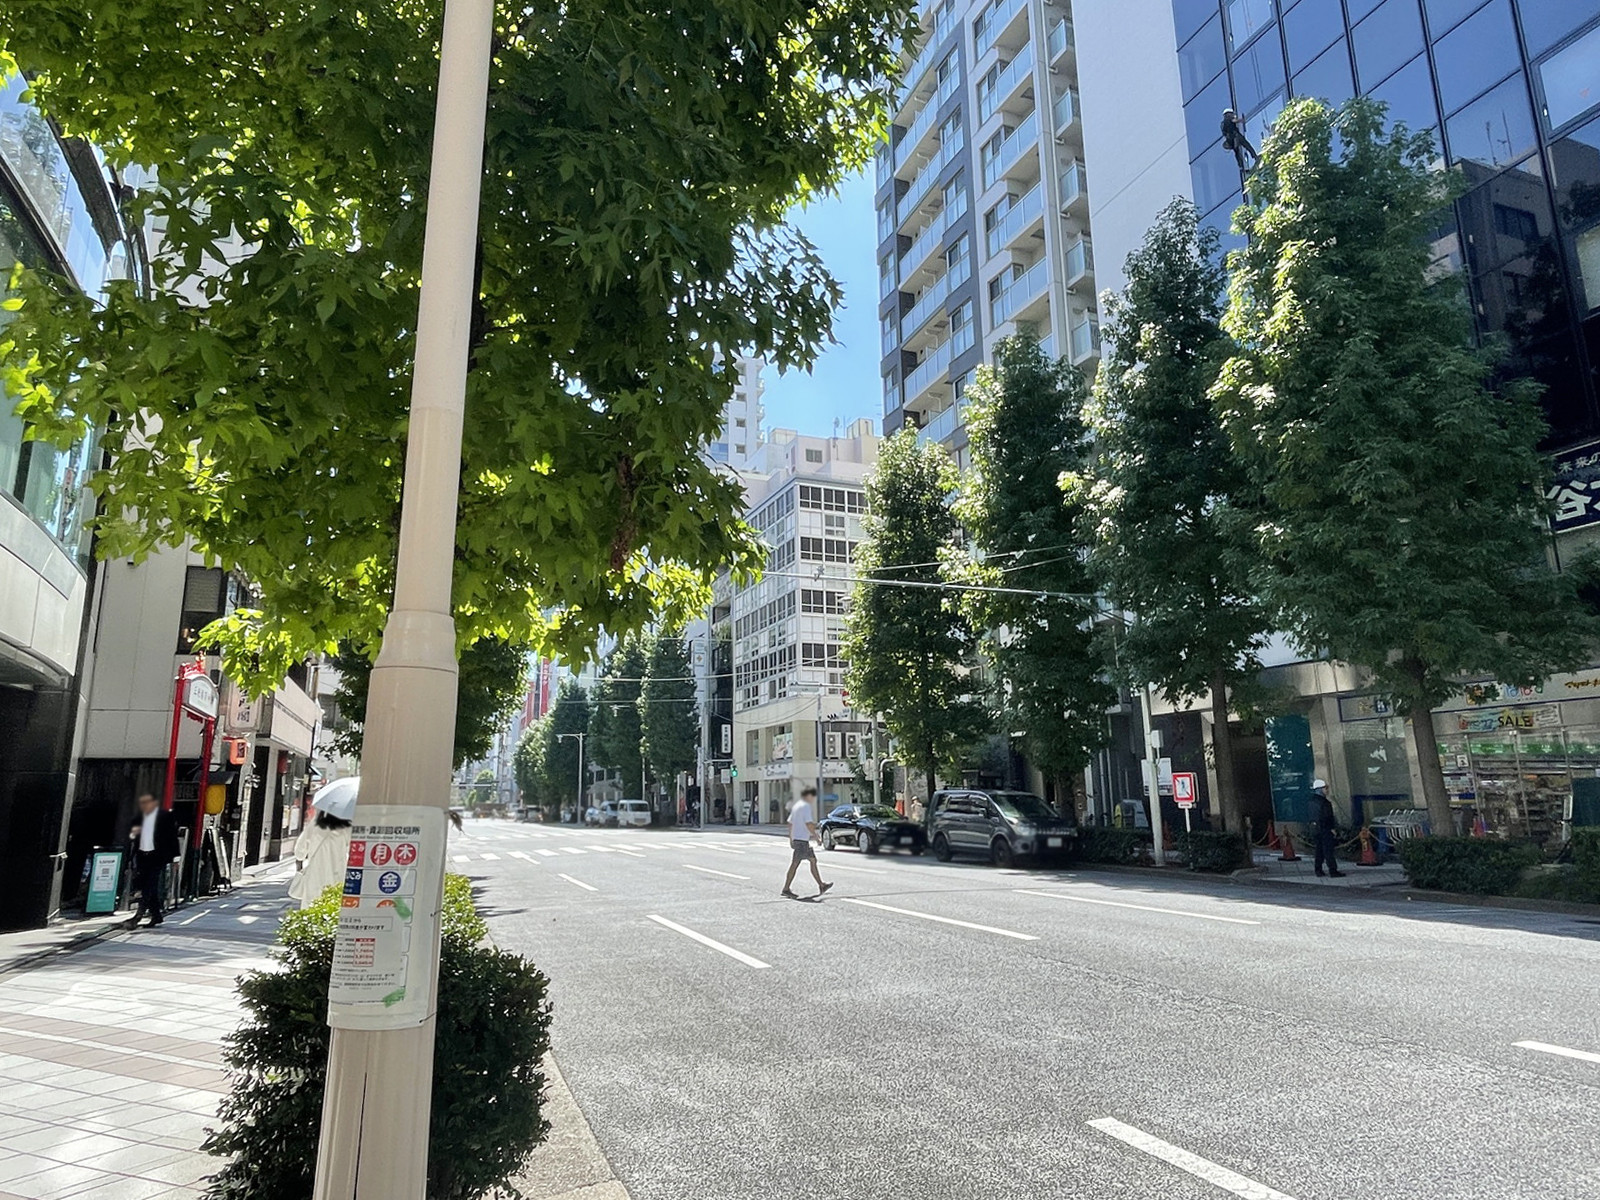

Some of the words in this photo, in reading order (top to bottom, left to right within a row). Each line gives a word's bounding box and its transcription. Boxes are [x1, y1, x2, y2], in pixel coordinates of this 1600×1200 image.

[1498, 715, 1533, 728] SALE
[374, 844, 388, 860] 月
[398, 844, 413, 860] 木
[382, 872, 398, 888] 金
